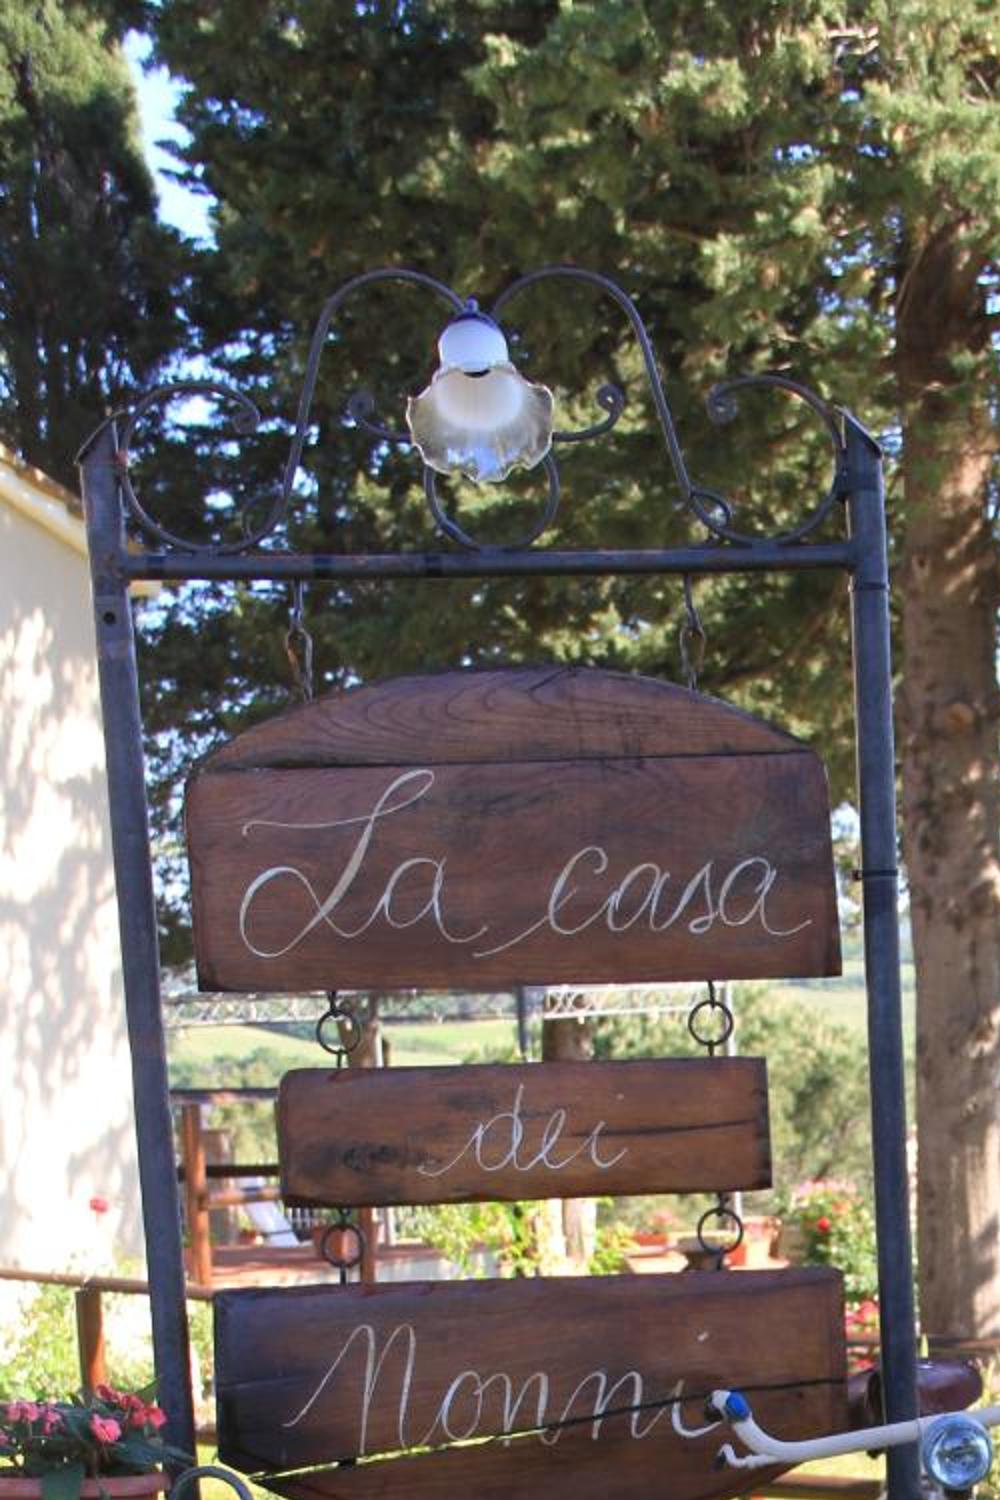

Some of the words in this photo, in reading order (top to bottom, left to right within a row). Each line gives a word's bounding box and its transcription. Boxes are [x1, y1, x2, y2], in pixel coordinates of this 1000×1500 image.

[239, 769, 489, 958] La
[417, 1083, 628, 1177] dei
[281, 1323, 723, 1456] Nonni
